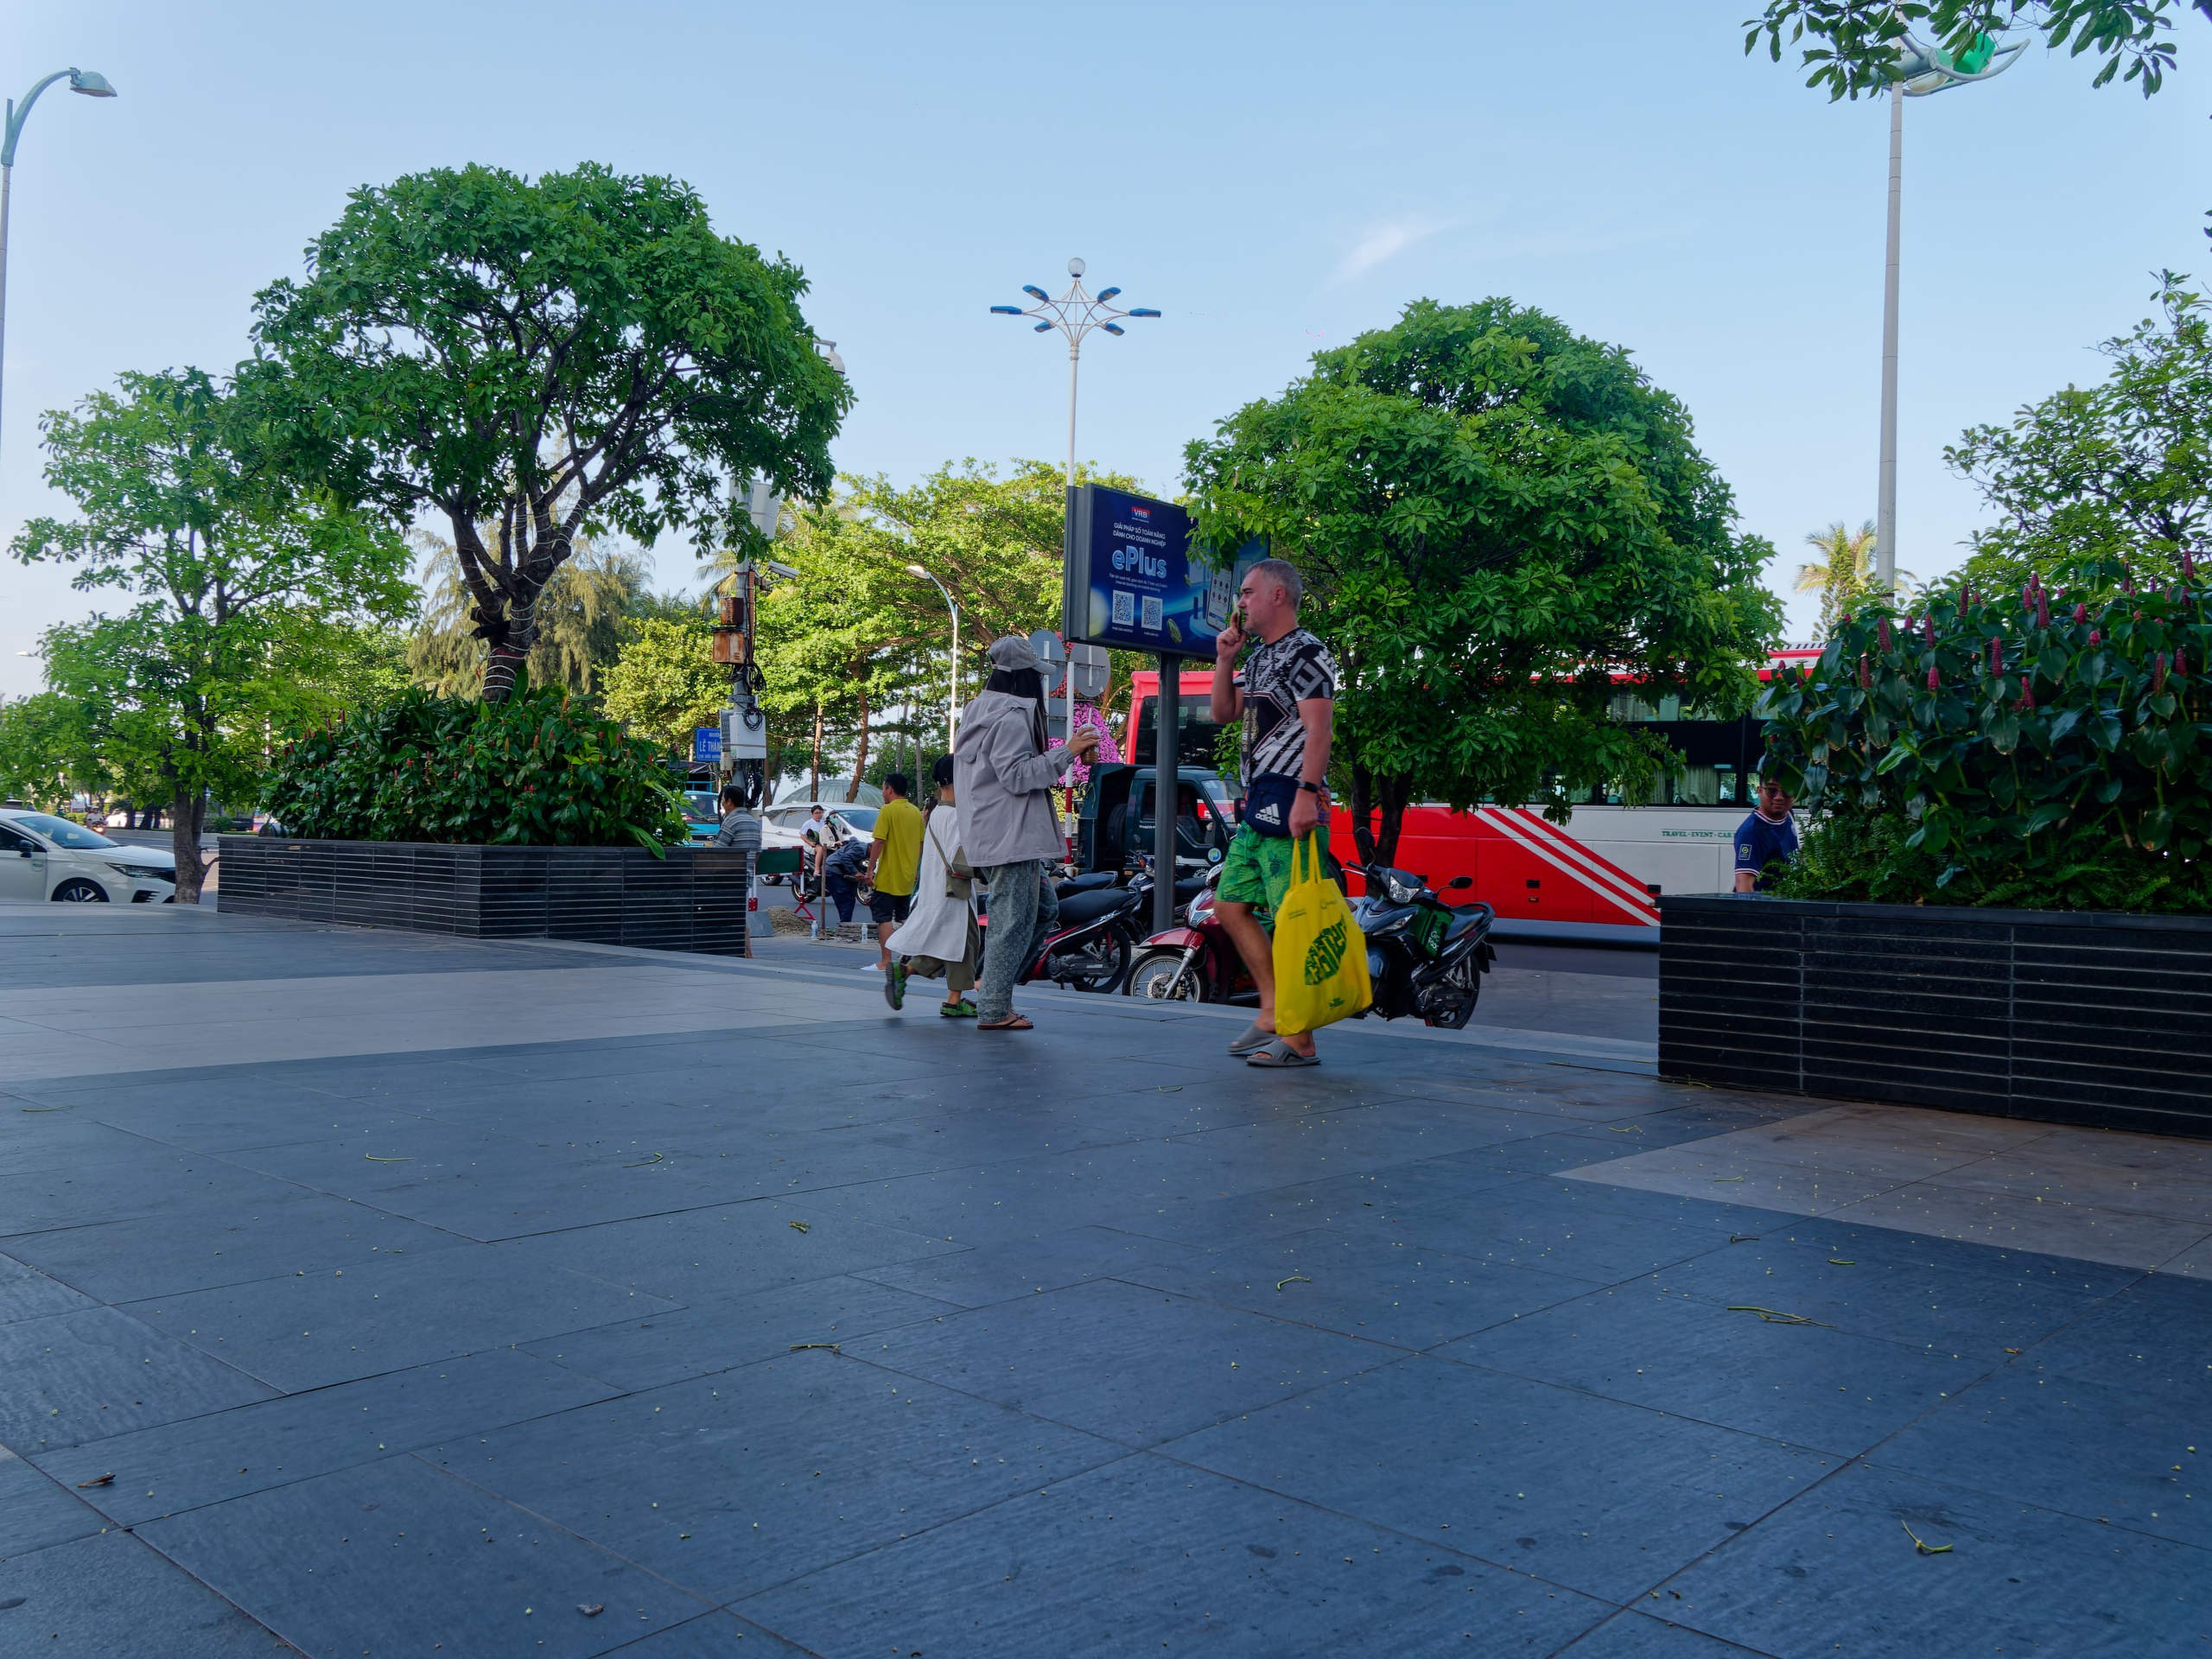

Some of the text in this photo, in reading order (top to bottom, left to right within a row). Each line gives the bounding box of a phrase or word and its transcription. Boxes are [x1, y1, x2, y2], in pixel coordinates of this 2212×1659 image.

[1134, 509, 1148, 518] VRB
[1112, 545, 1167, 579] ePlus
[1255, 813, 1281, 825] adidas
